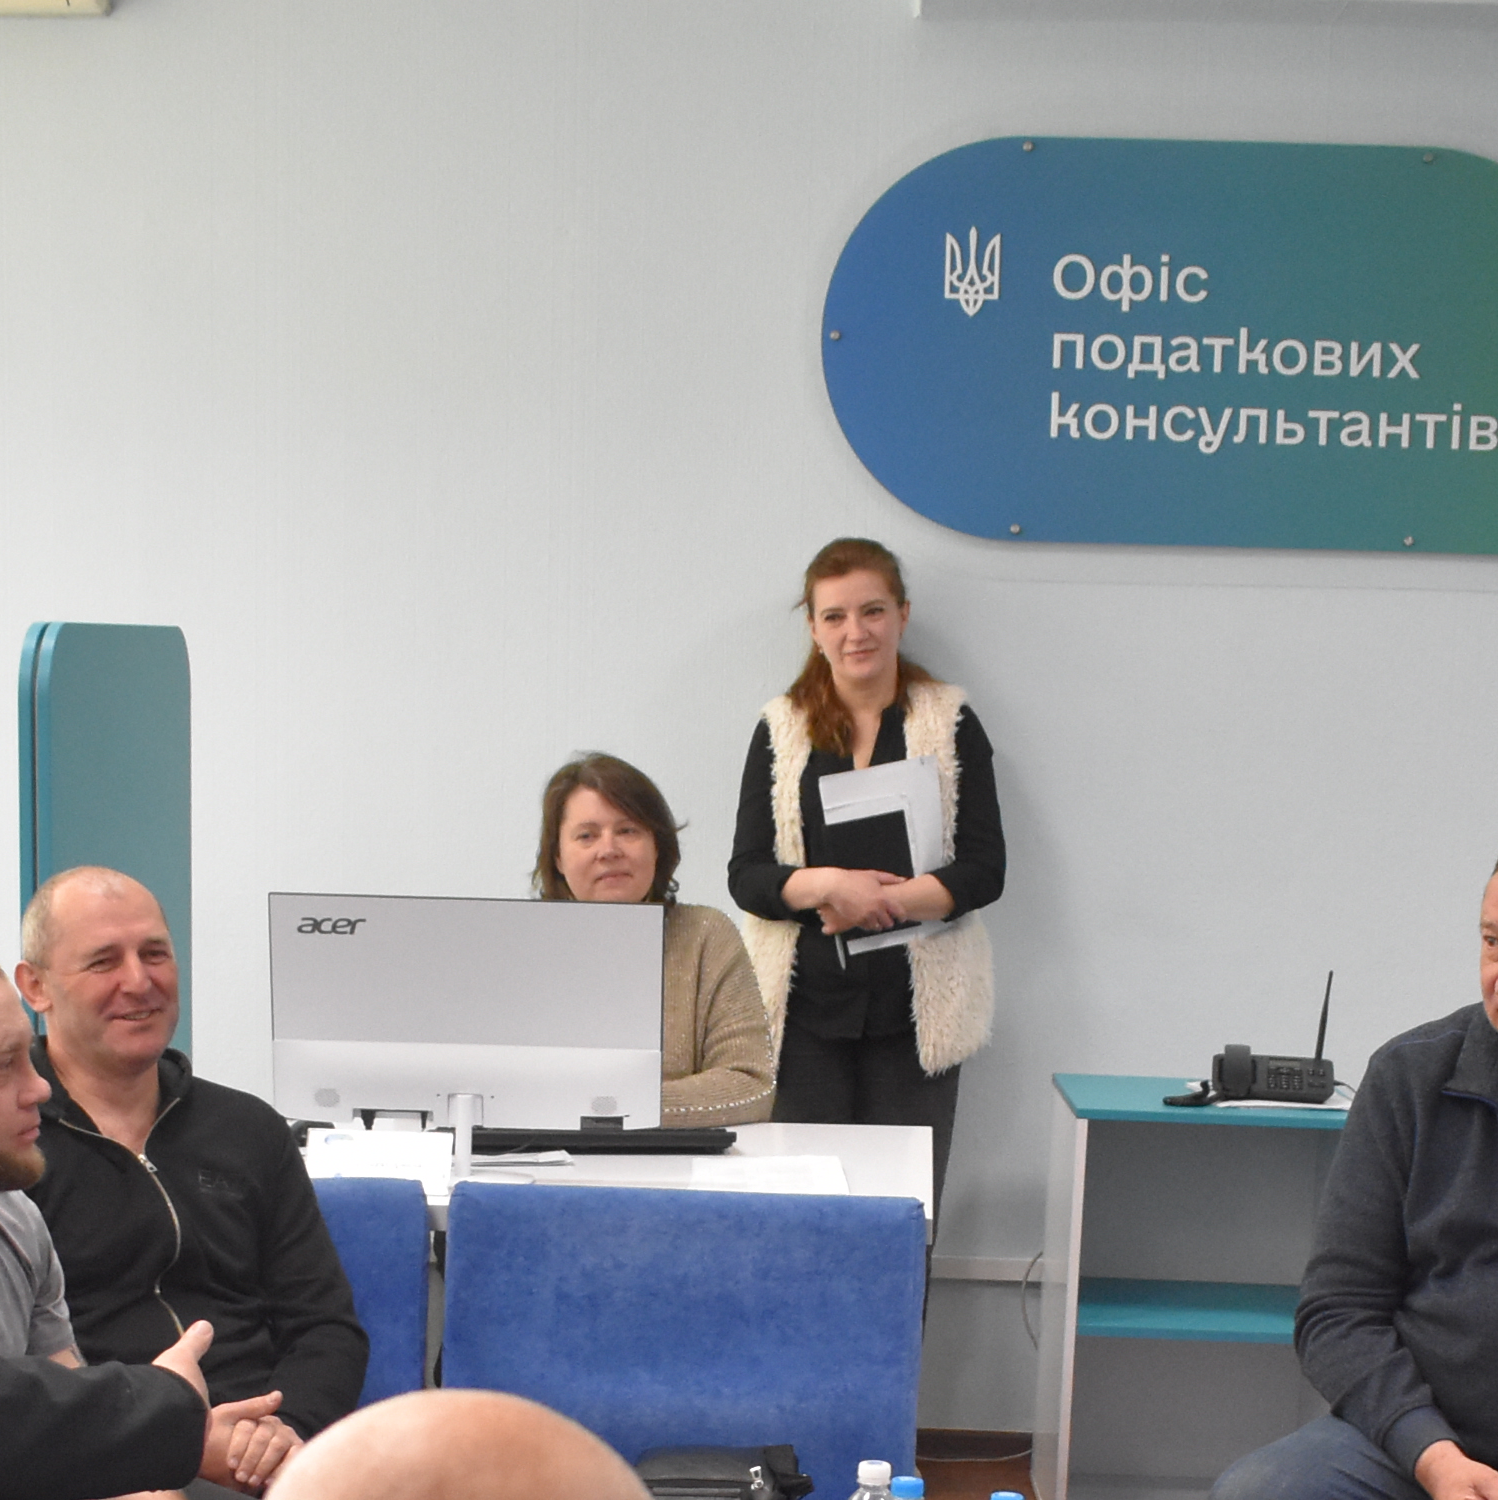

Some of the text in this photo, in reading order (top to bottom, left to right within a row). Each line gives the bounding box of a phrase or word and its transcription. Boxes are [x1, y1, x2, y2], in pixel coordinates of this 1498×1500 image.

[1052, 253, 1209, 313] Офіс
[1051, 326, 1421, 380] податкових
[1048, 391, 1498, 455] консультантів
[297, 916, 367, 935] acer
